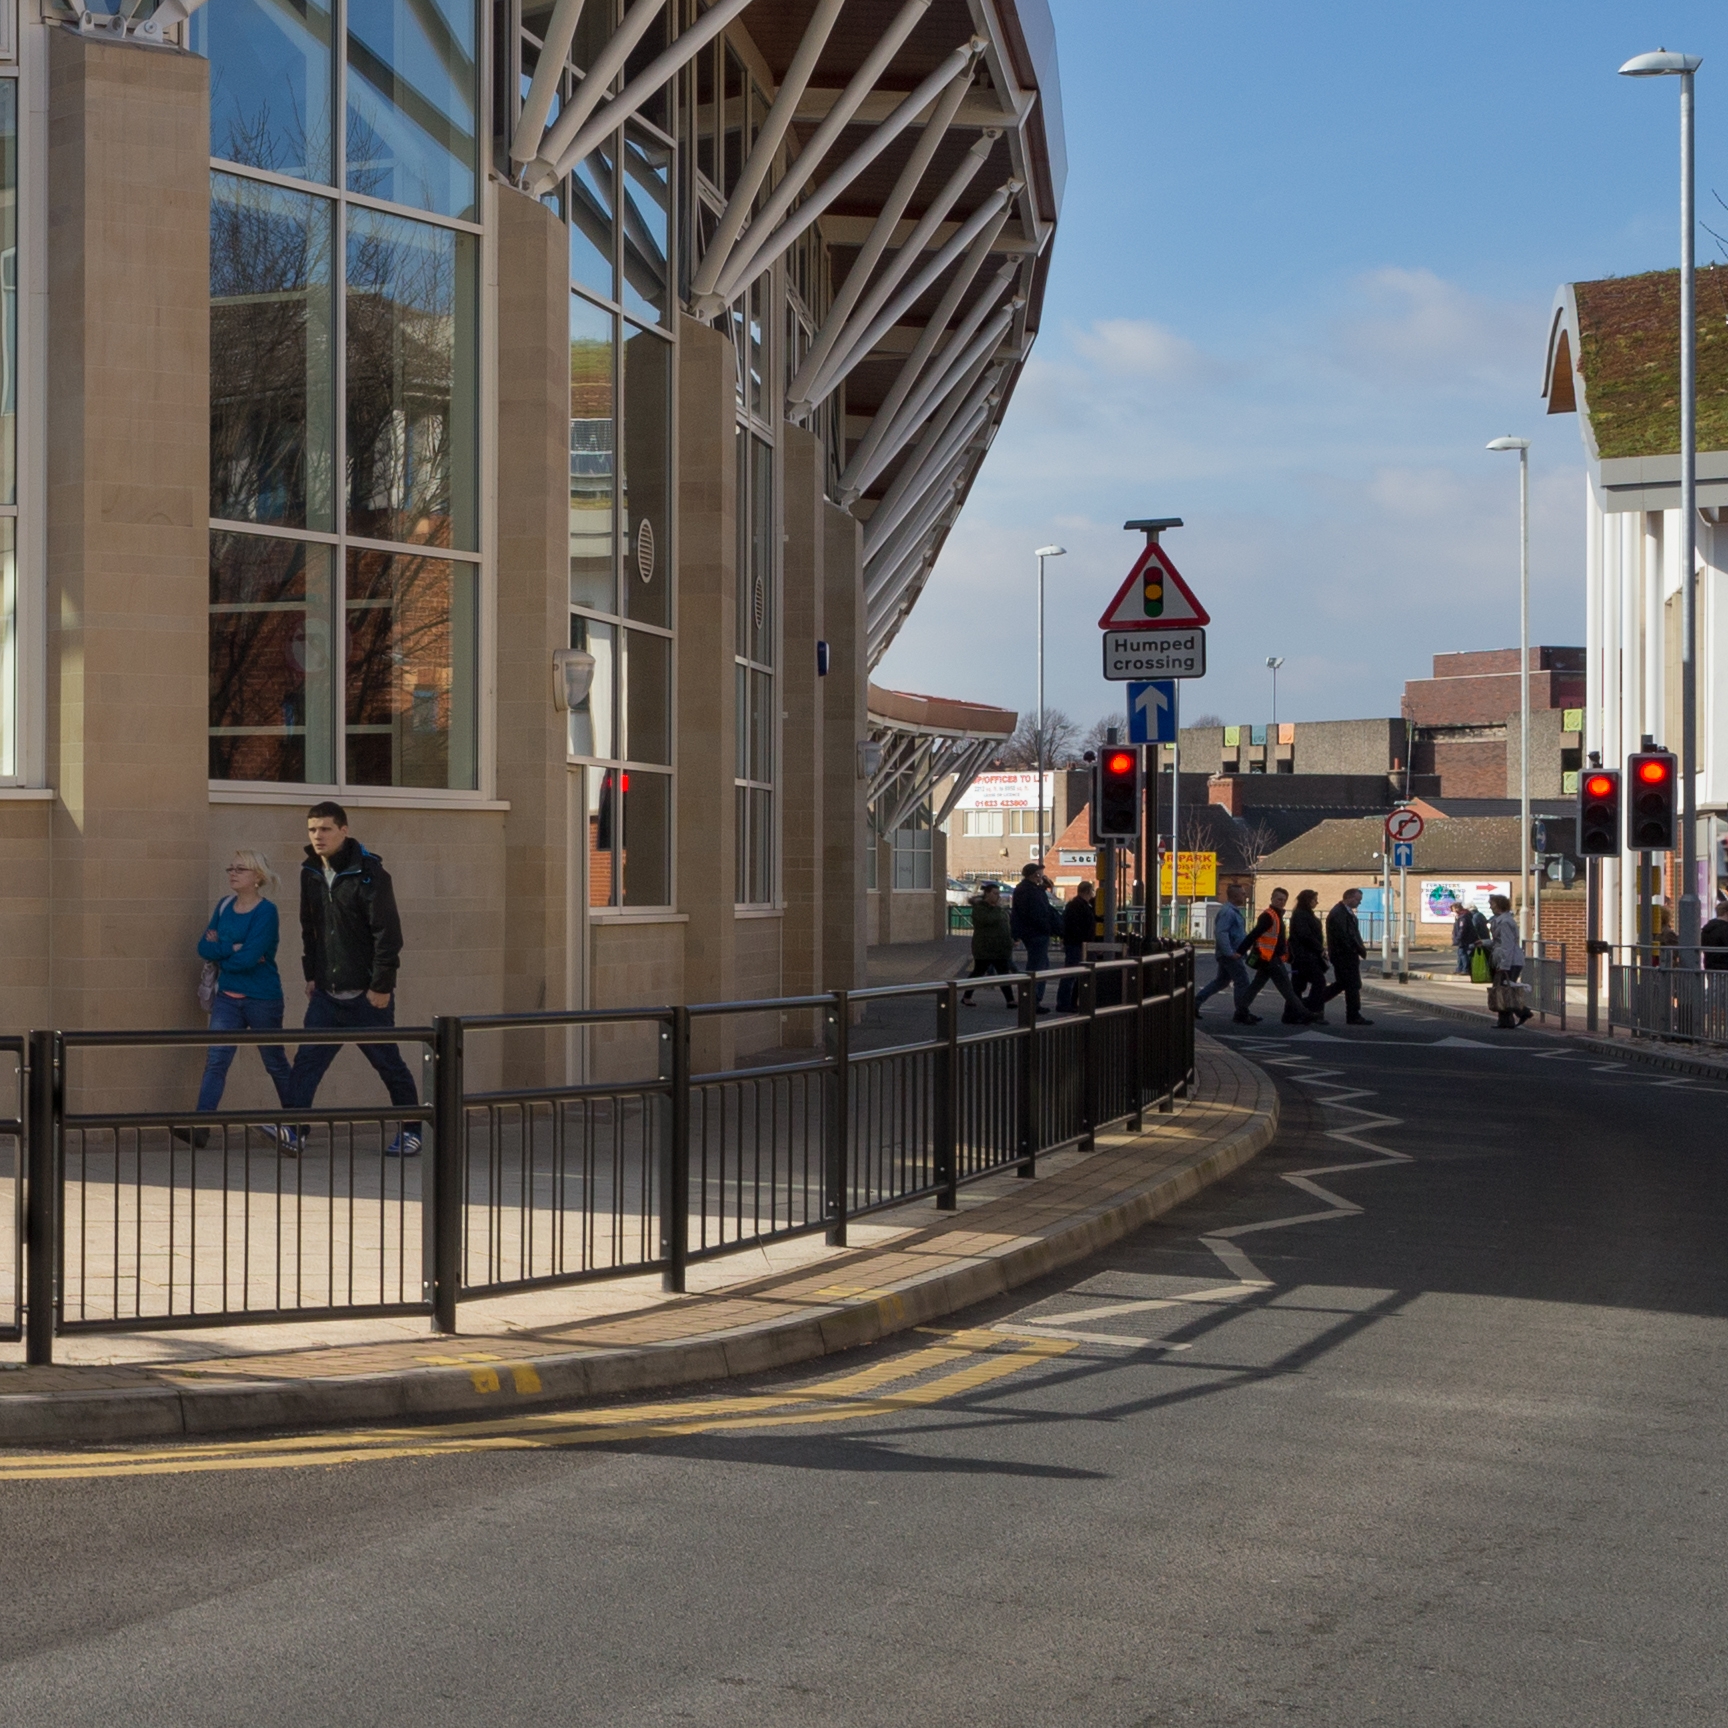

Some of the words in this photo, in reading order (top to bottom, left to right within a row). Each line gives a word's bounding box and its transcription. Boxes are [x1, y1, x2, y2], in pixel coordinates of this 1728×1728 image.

[1114, 635, 1195, 653] Humped
[1113, 655, 1195, 671] crossing
[1020, 774, 1031, 783] TO
[1033, 773, 1049, 783] LT
